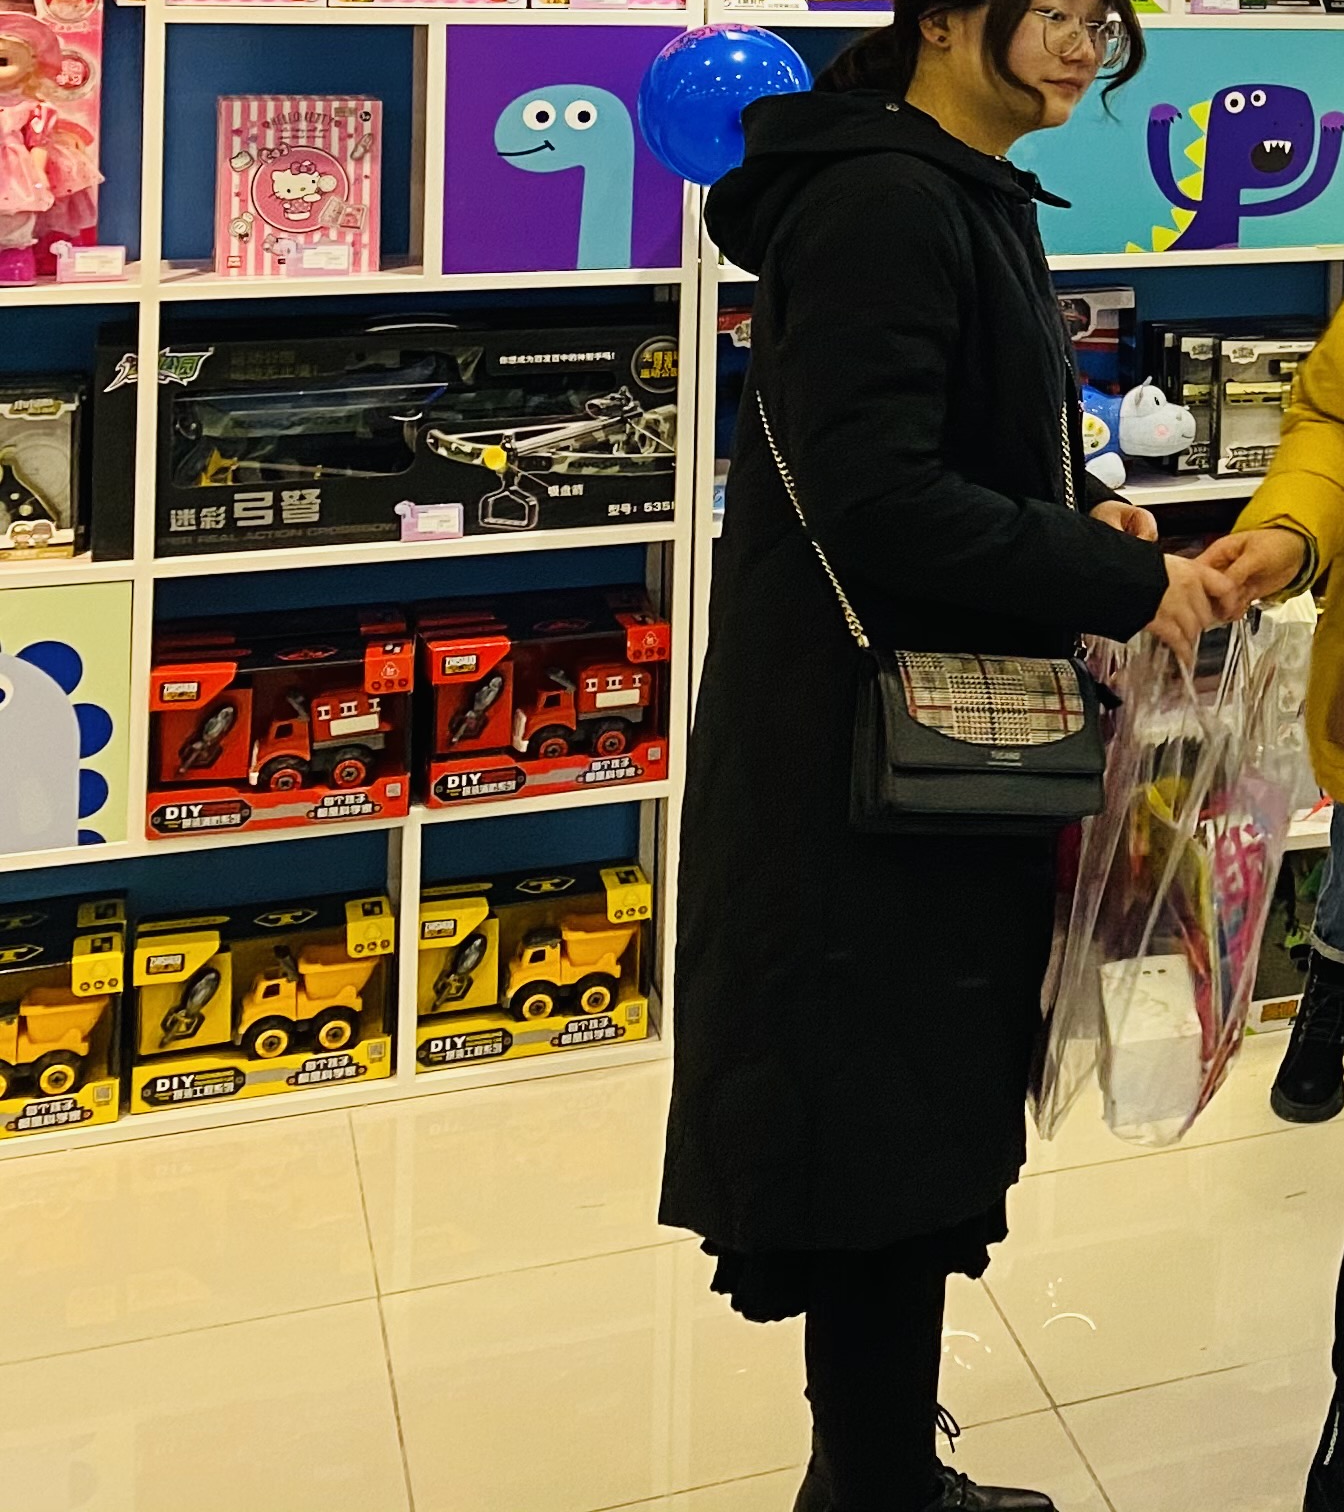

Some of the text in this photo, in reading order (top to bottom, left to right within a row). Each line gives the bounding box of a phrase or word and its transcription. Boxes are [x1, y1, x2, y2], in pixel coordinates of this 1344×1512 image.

[447, 773, 482, 787] DIY
[165, 805, 204, 820] DIY
[430, 1035, 467, 1052] DIY
[156, 1074, 195, 1092] DIY
